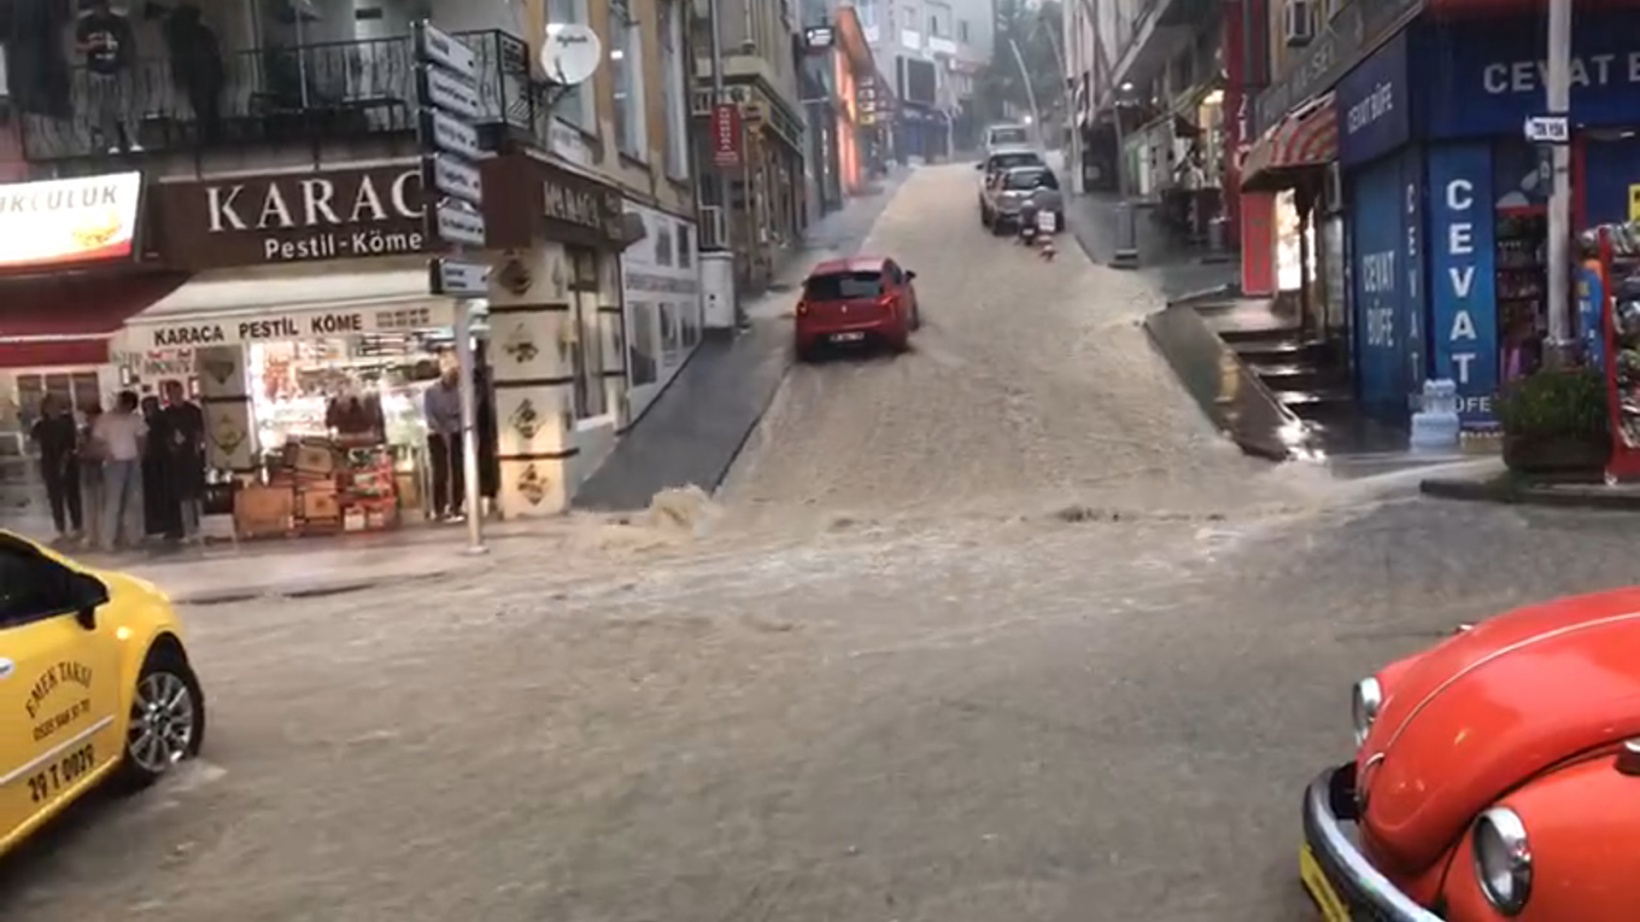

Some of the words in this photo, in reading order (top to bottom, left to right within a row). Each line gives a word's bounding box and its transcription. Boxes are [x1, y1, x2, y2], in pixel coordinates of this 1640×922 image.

[264, 231, 423, 260] Pestil-Köme
[1446, 178, 1476, 384] CEVAT
[154, 322, 225, 347] KARACA
